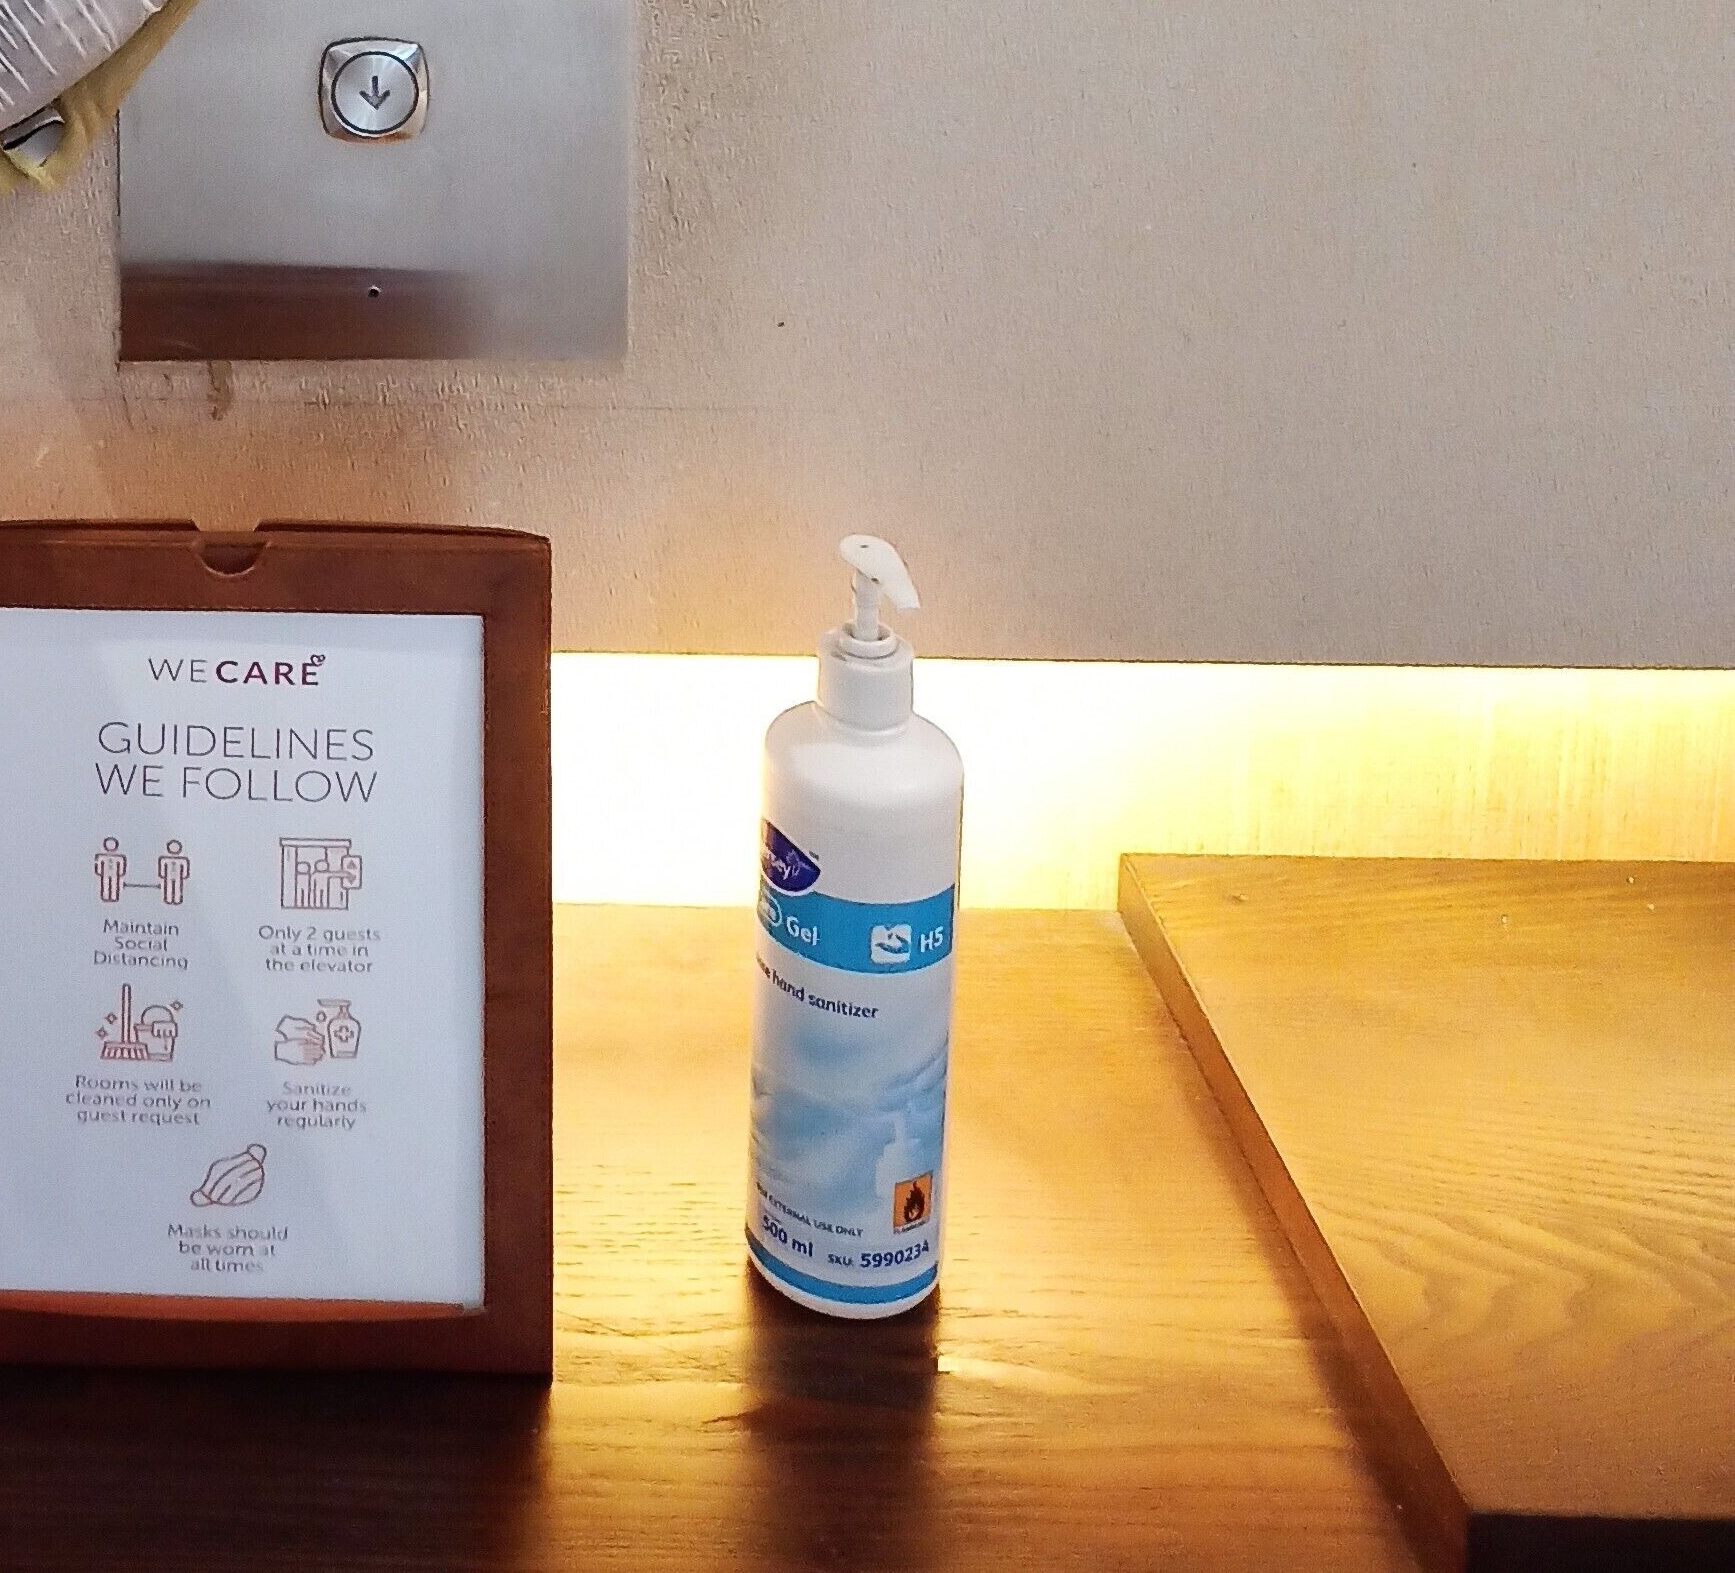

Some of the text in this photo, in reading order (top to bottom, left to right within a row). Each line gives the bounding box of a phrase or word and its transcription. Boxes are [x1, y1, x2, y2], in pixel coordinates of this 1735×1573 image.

[98, 721, 374, 761] GUIDELINES
[95, 762, 378, 803] WE FOLLOW
[103, 918, 179, 936] Maintain
[258, 925, 381, 943] Only 2 guests
[786, 916, 818, 946] Gel
[114, 937, 168, 952] Social
[270, 942, 369, 957] at a time in
[94, 950, 189, 971] Distancing
[265, 958, 374, 973] the elevator
[772, 968, 879, 1019] hand sanitizer
[75, 1074, 202, 1093] Rooms will be
[282, 1081, 352, 1096] Sanitize
[65, 1090, 211, 1111] cleaned only on
[266, 1097, 367, 1115] your hands
[76, 1109, 201, 1126] guest request
[277, 1114, 357, 1132] regularly
[167, 1223, 289, 1241] Masks should
[762, 1214, 814, 1258] 500 ml
[836, 1225, 864, 1238] ONLY
[178, 1239, 276, 1257] be worn at
[860, 1239, 929, 1268] 5990234
[190, 1257, 264, 1273] all times
